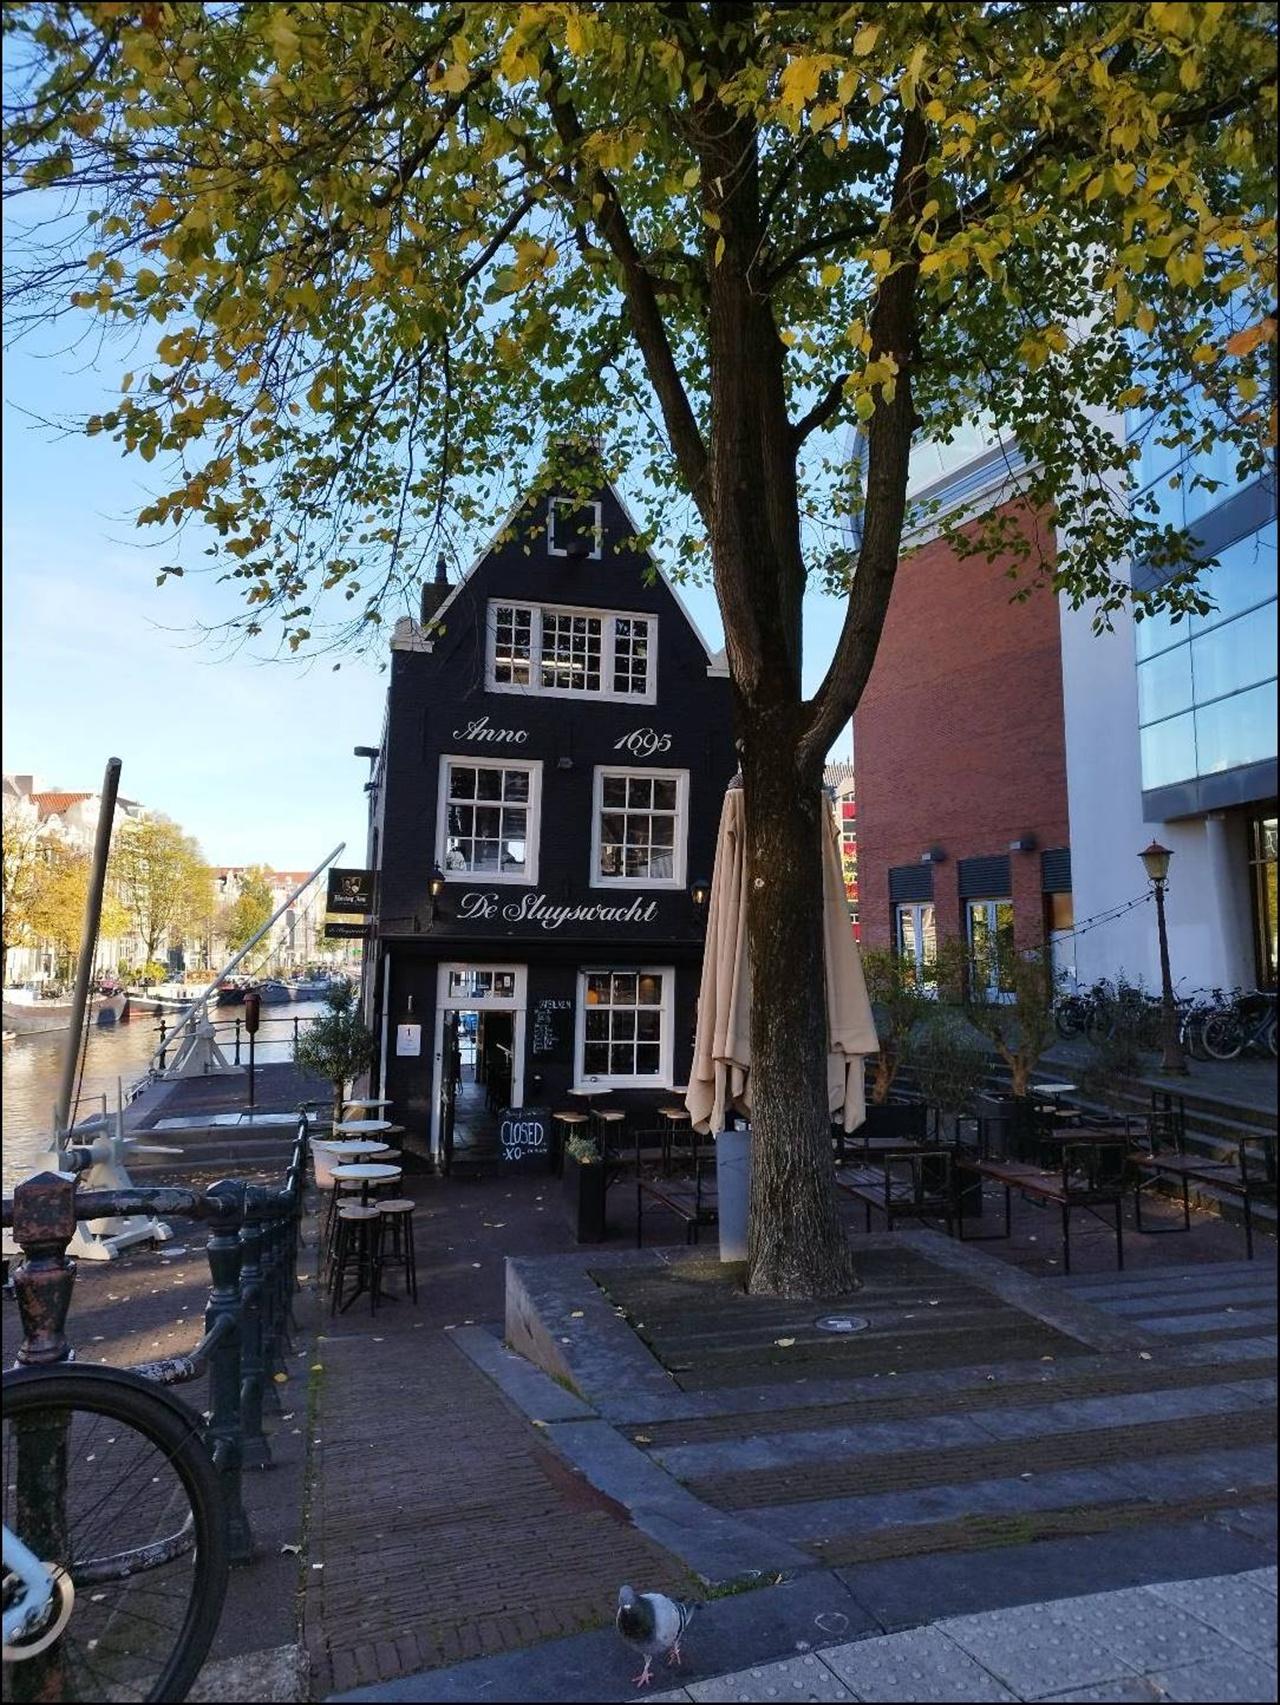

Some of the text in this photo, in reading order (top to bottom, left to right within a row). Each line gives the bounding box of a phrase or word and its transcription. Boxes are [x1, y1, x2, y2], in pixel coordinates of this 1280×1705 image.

[453, 716, 673, 757] Anno 1695
[457, 892, 658, 930] De Sluyswacht
[500, 1120, 544, 1146] CLOSED
